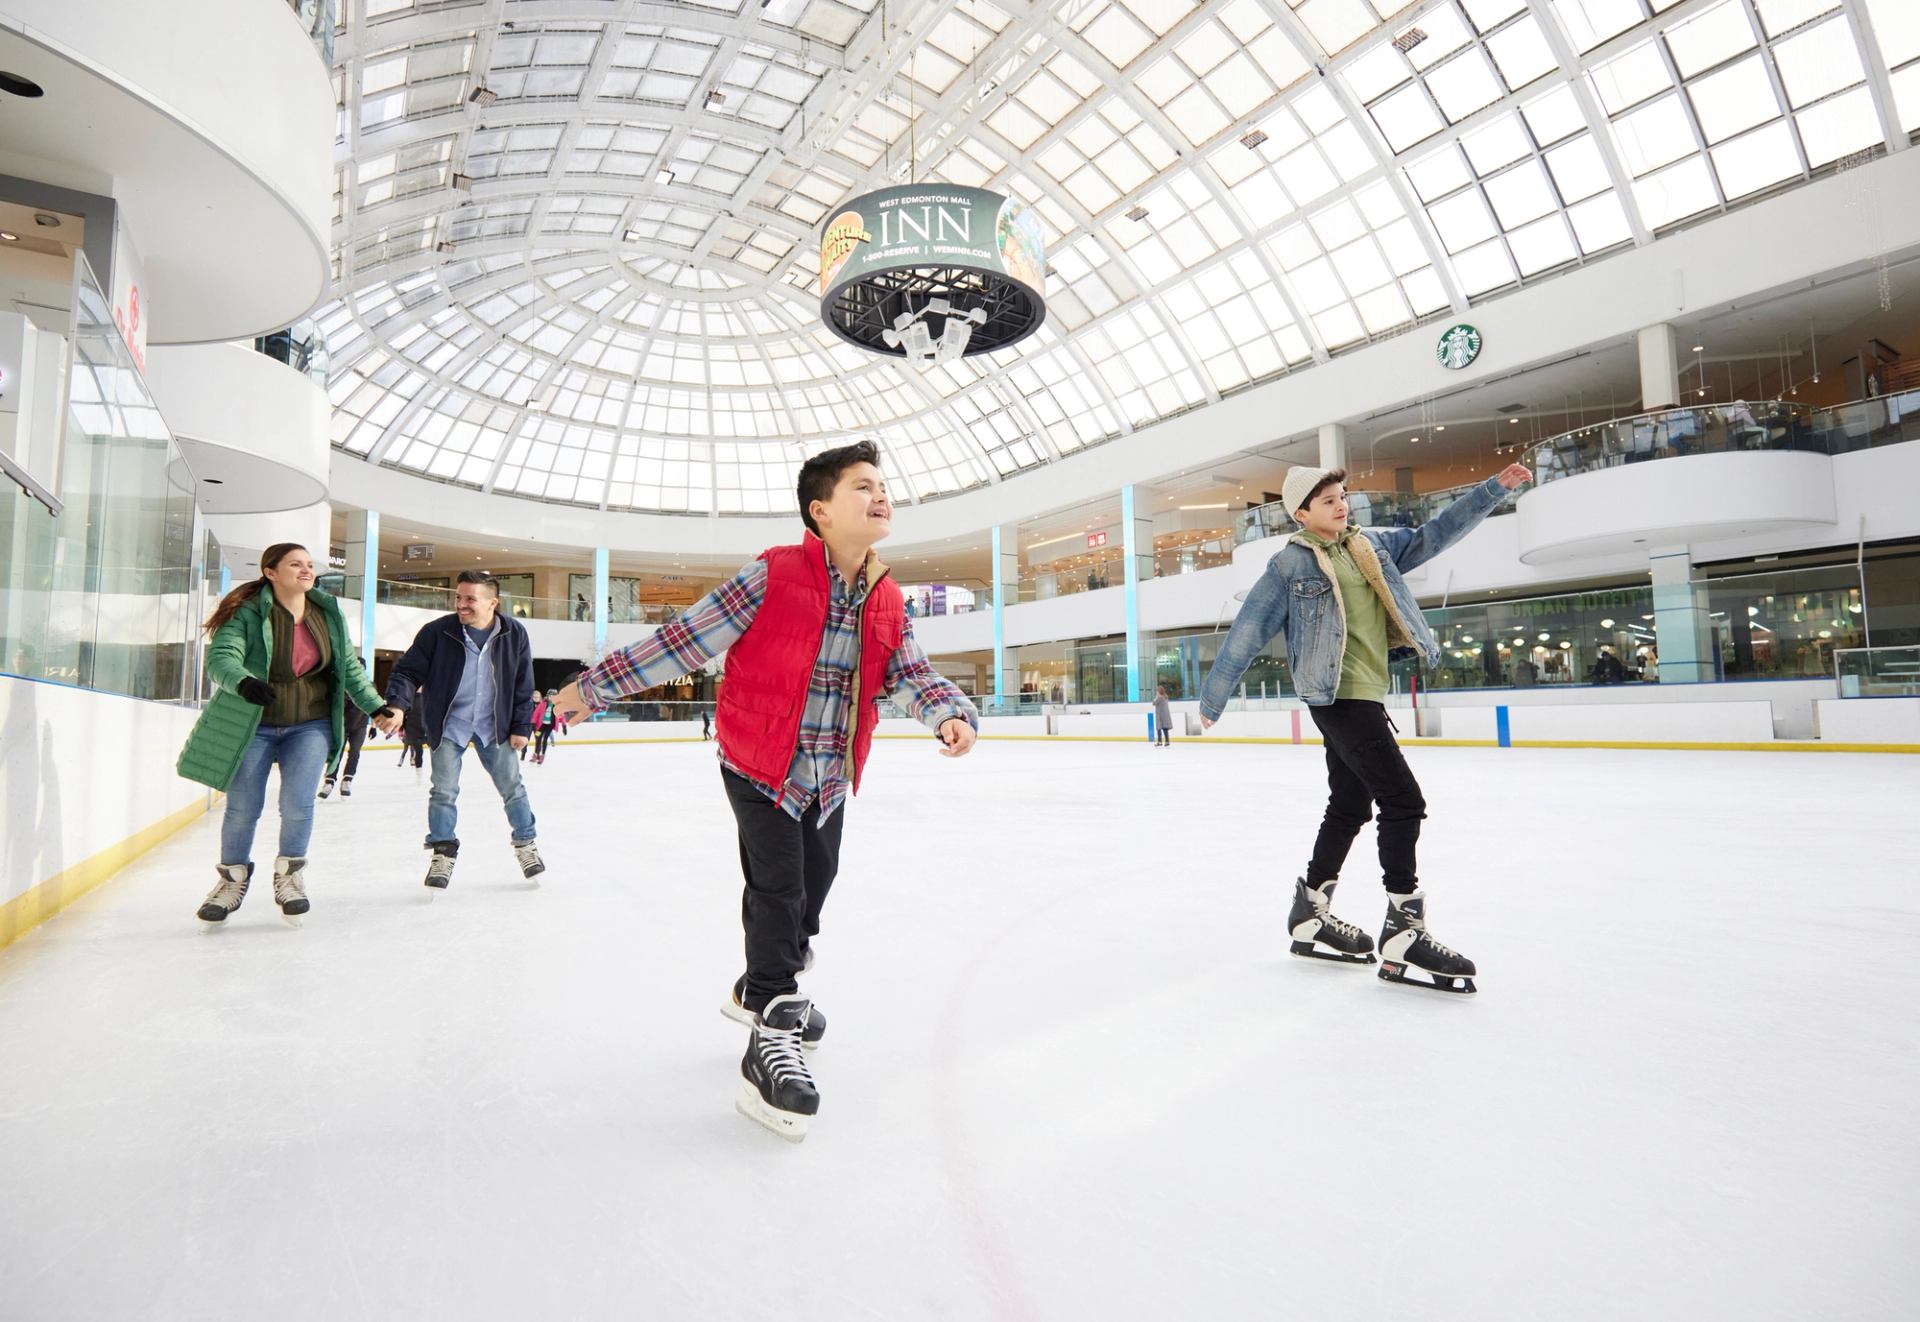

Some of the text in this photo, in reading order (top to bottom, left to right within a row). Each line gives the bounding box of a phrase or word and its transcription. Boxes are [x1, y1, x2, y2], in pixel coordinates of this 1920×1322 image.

[879, 195, 972, 208] WEST EDMONTON MALL
[880, 205, 972, 247] INN
